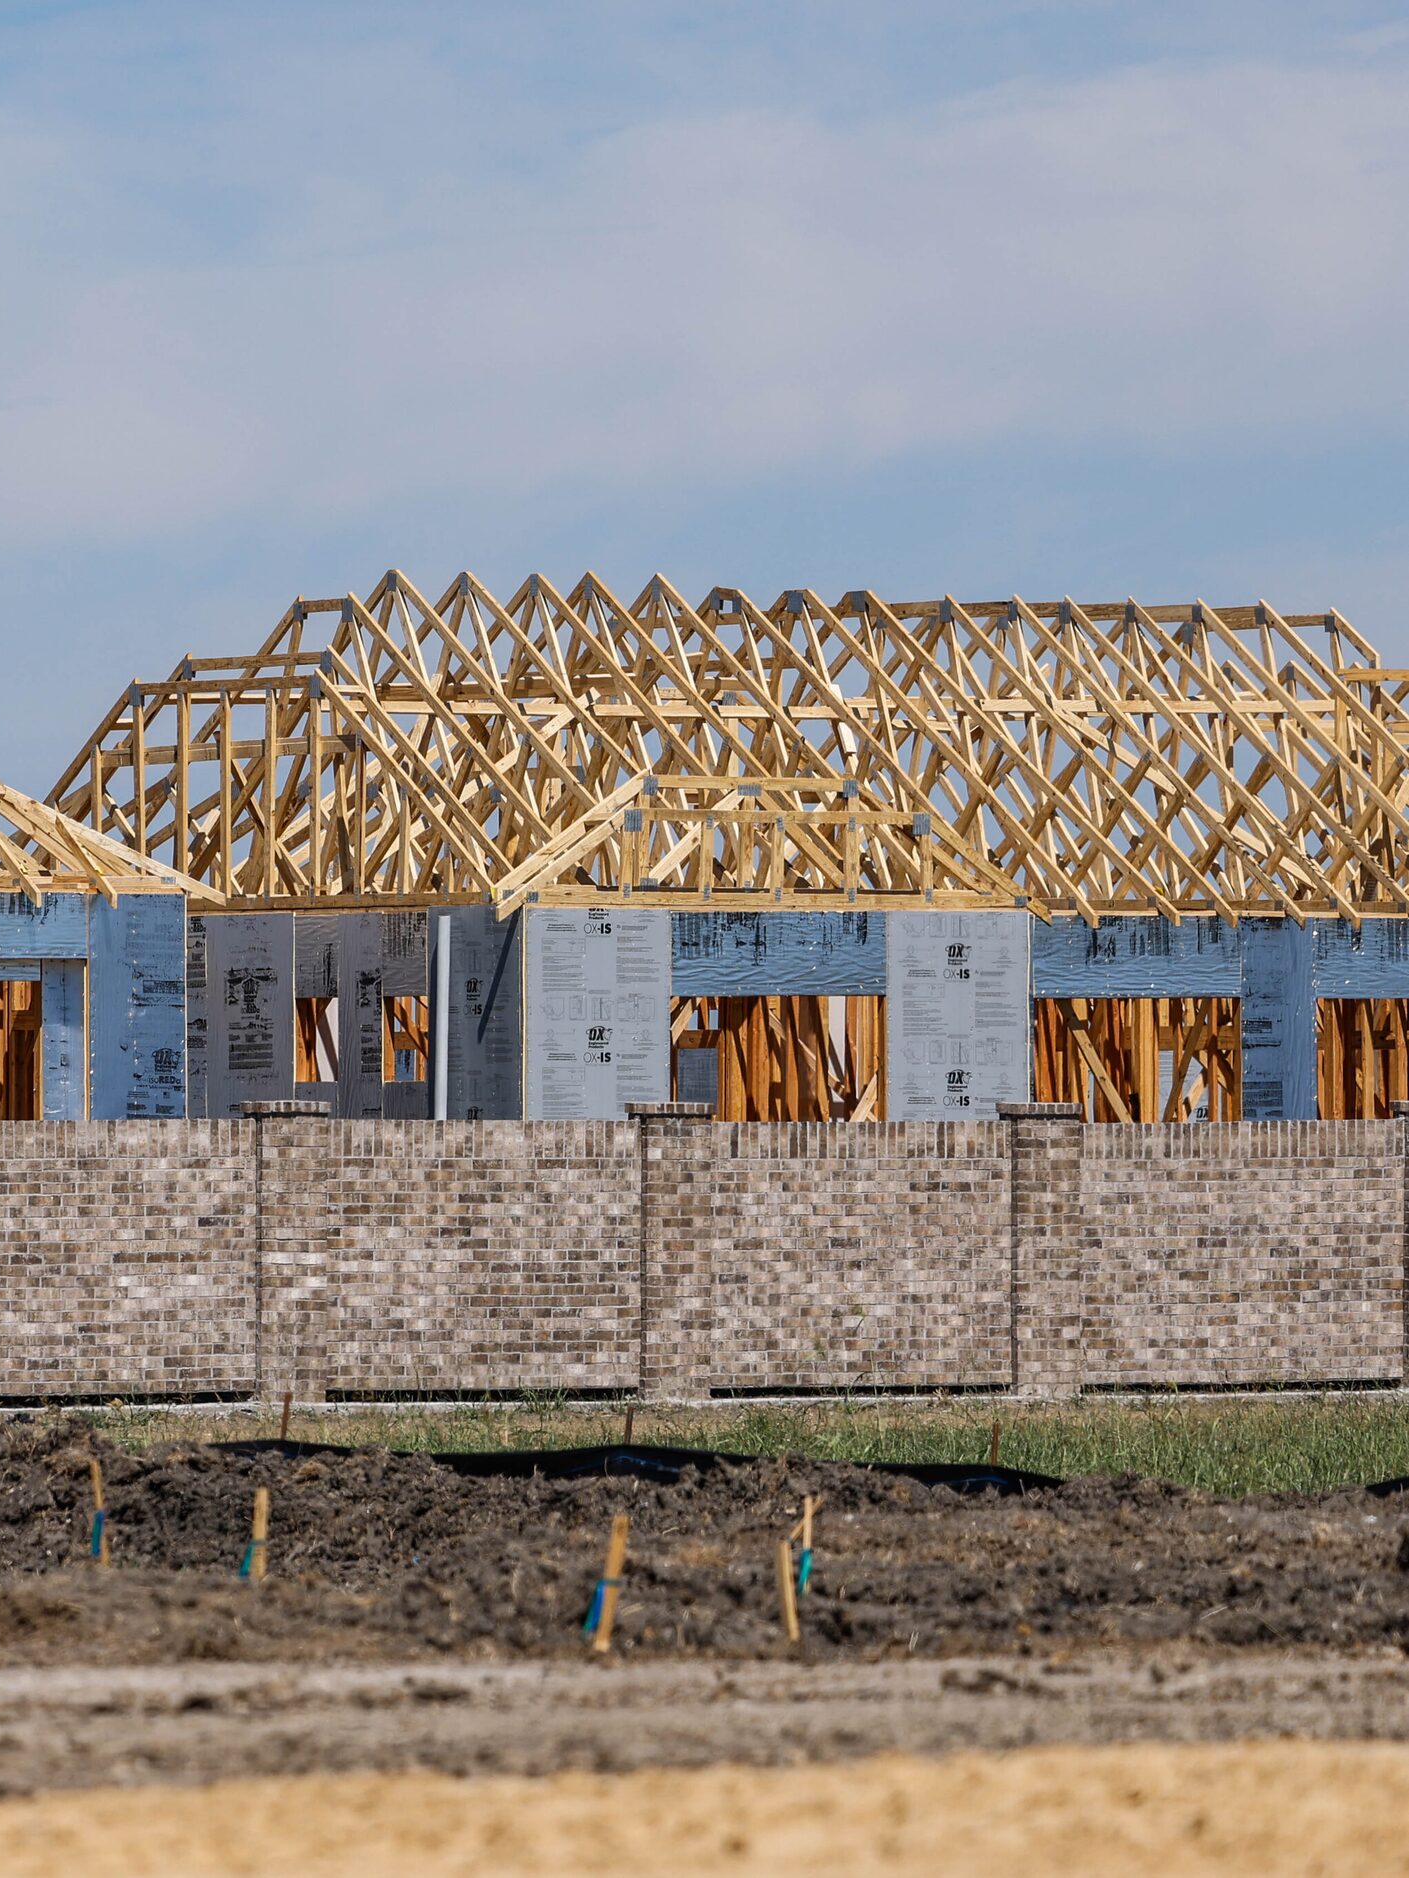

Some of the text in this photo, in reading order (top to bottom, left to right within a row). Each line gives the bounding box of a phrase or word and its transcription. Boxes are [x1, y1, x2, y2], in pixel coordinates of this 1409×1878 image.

[583, 922, 612, 935] OX-IS
[942, 968, 970, 979] OX-IS
[583, 1052, 611, 1063] OX-IS
[942, 1095, 970, 1107] OX-IS
